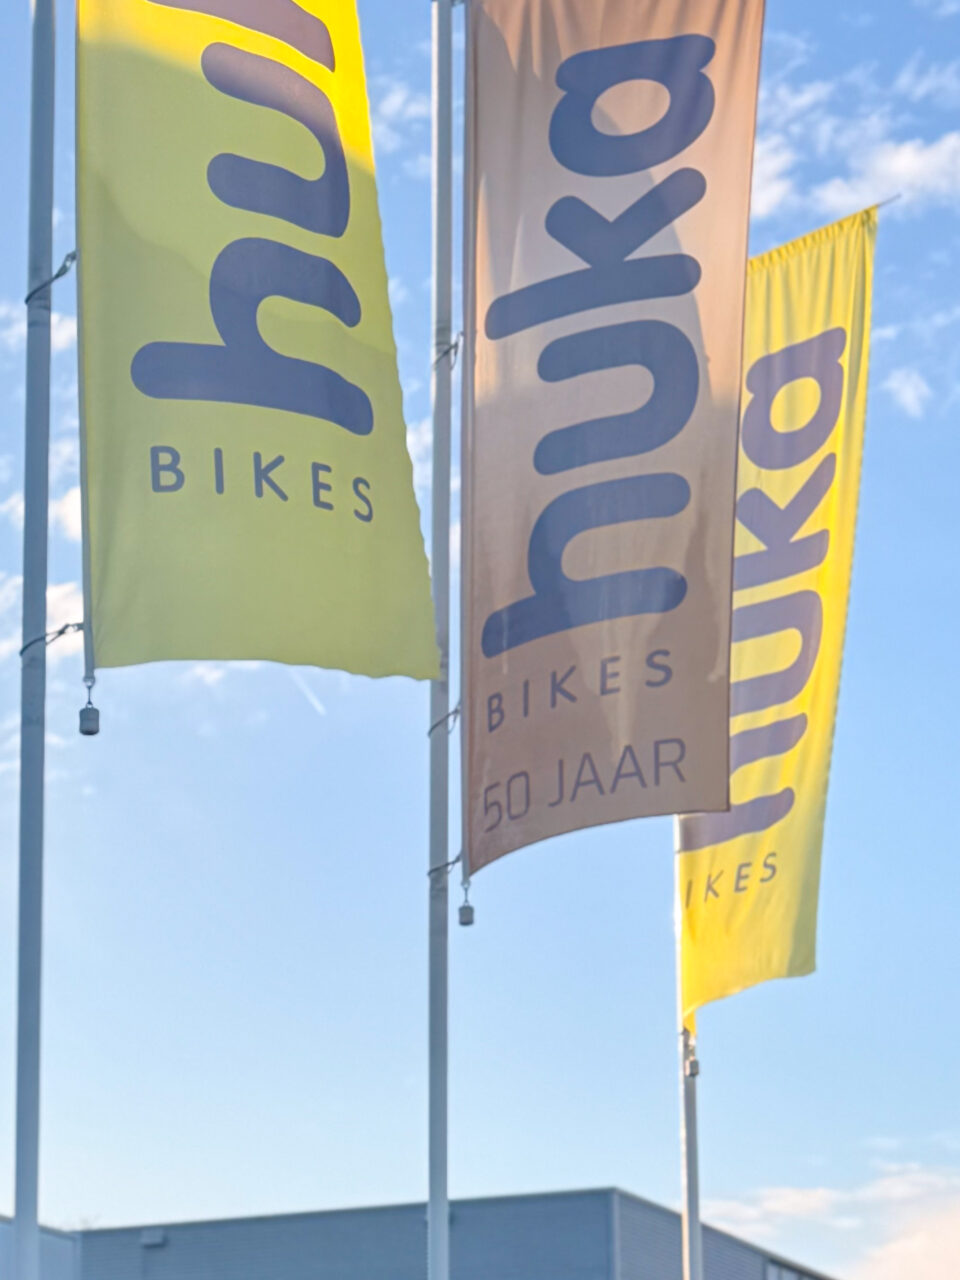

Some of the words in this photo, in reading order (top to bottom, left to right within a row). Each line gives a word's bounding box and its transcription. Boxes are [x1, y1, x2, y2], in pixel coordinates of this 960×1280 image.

[480, 33, 717, 659] huka
[149, 444, 374, 523] BIKES
[486, 648, 674, 733] BIKES
[482, 770, 531, 833] 50
[548, 737, 688, 808] JAAR
[685, 852, 778, 909] IKES
